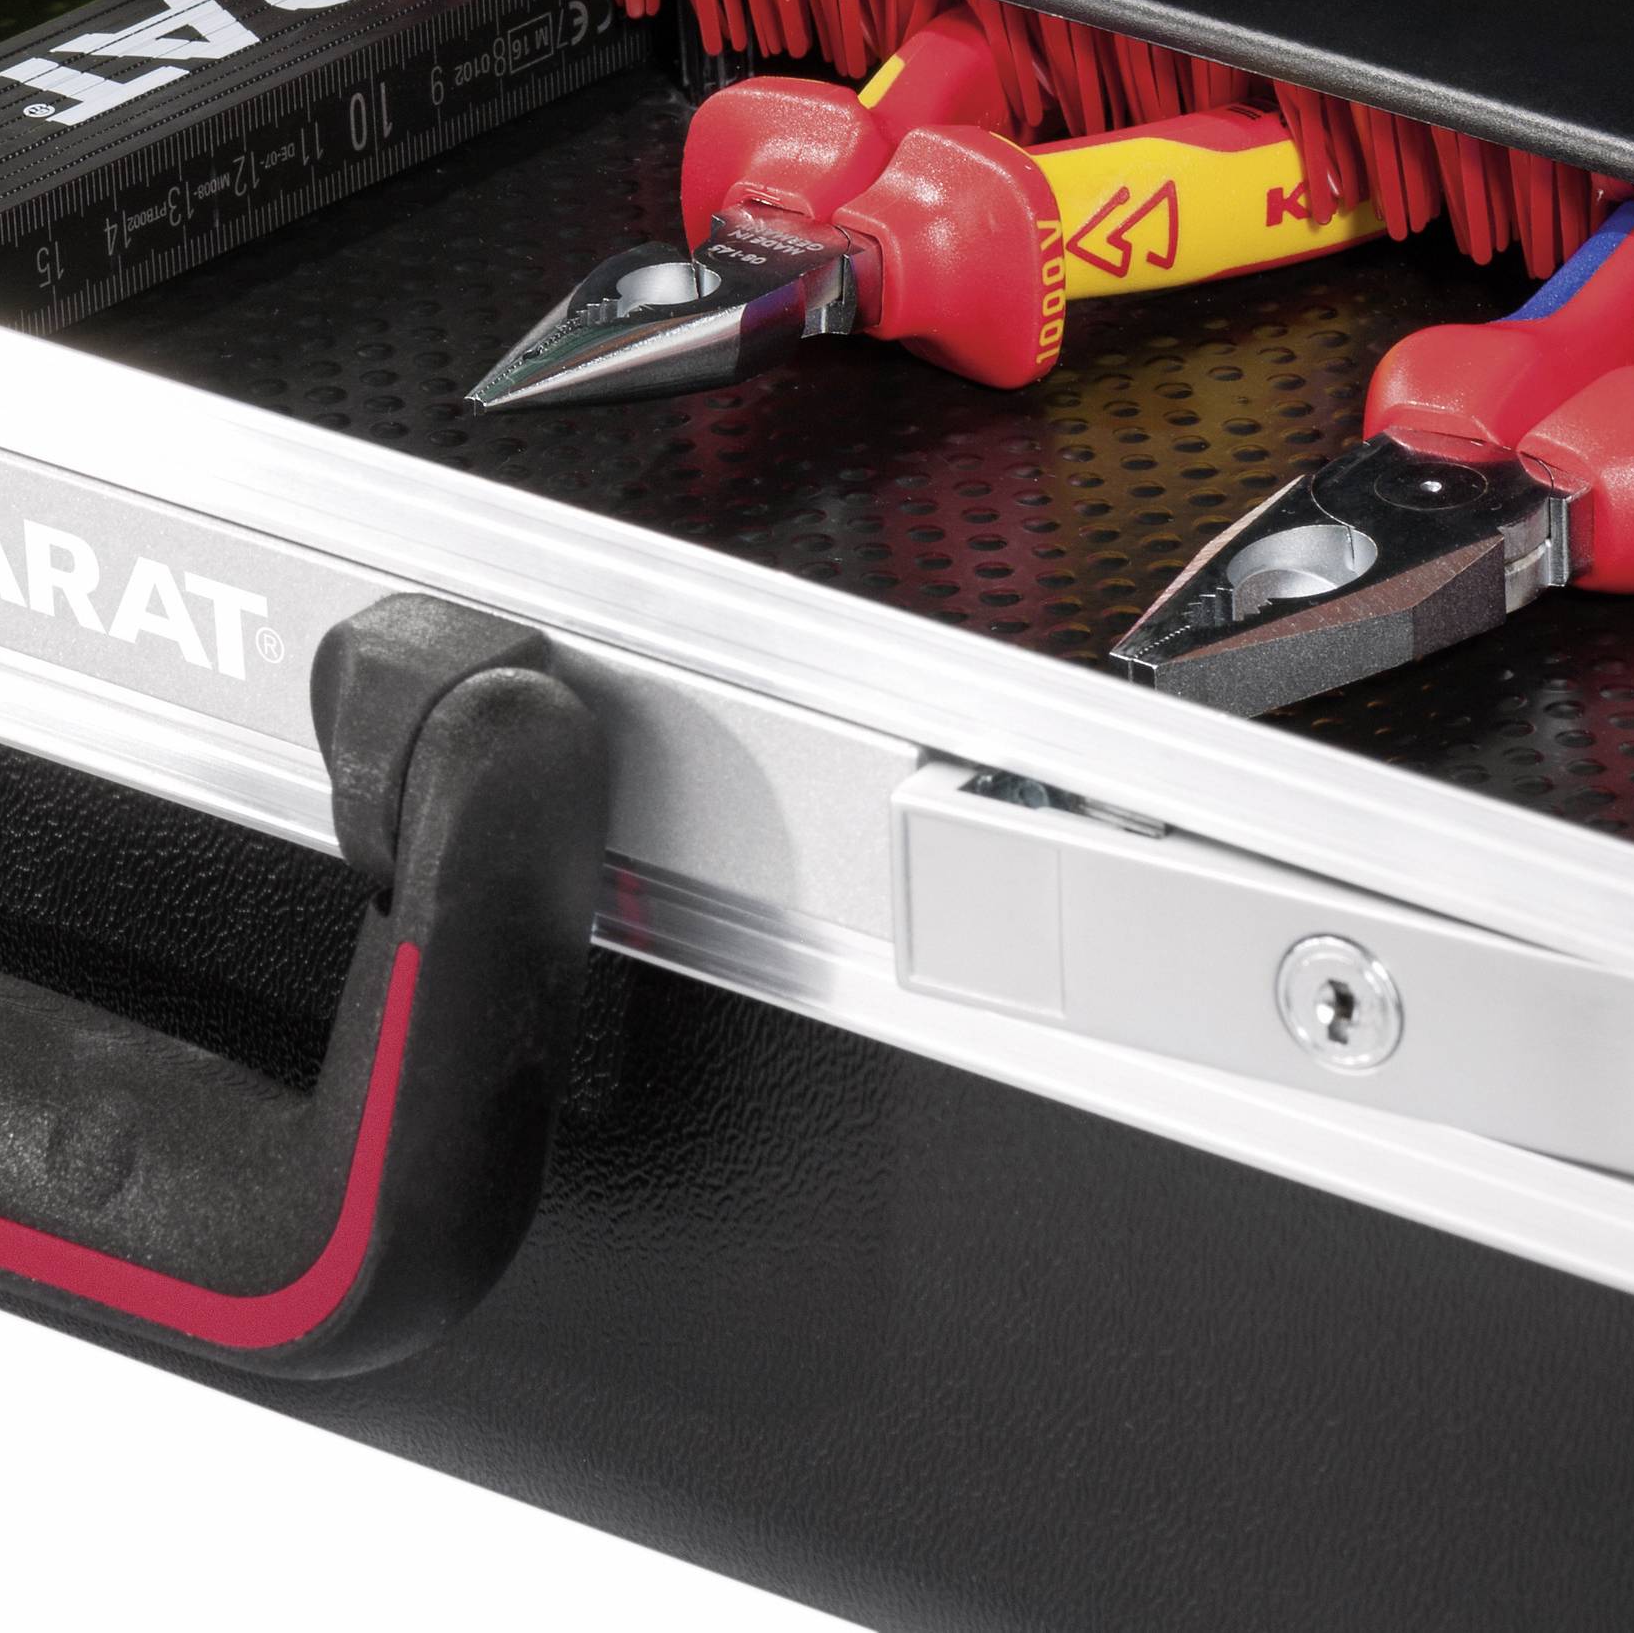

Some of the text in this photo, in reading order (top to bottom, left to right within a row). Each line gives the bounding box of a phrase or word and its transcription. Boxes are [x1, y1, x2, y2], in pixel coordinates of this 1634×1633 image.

[454, 53, 490, 87] 0102
[493, 37, 506, 76] 8
[430, 65, 444, 105] 9
[349, 81, 393, 151] 10
[301, 121, 324, 165] 11
[233, 150, 260, 197] 12
[168, 181, 195, 226] 13
[104, 209, 132, 256] 14
[753, 236, 806, 256] MADE
[36, 241, 64, 288] 15
[1036, 219, 1066, 364] 1000V
